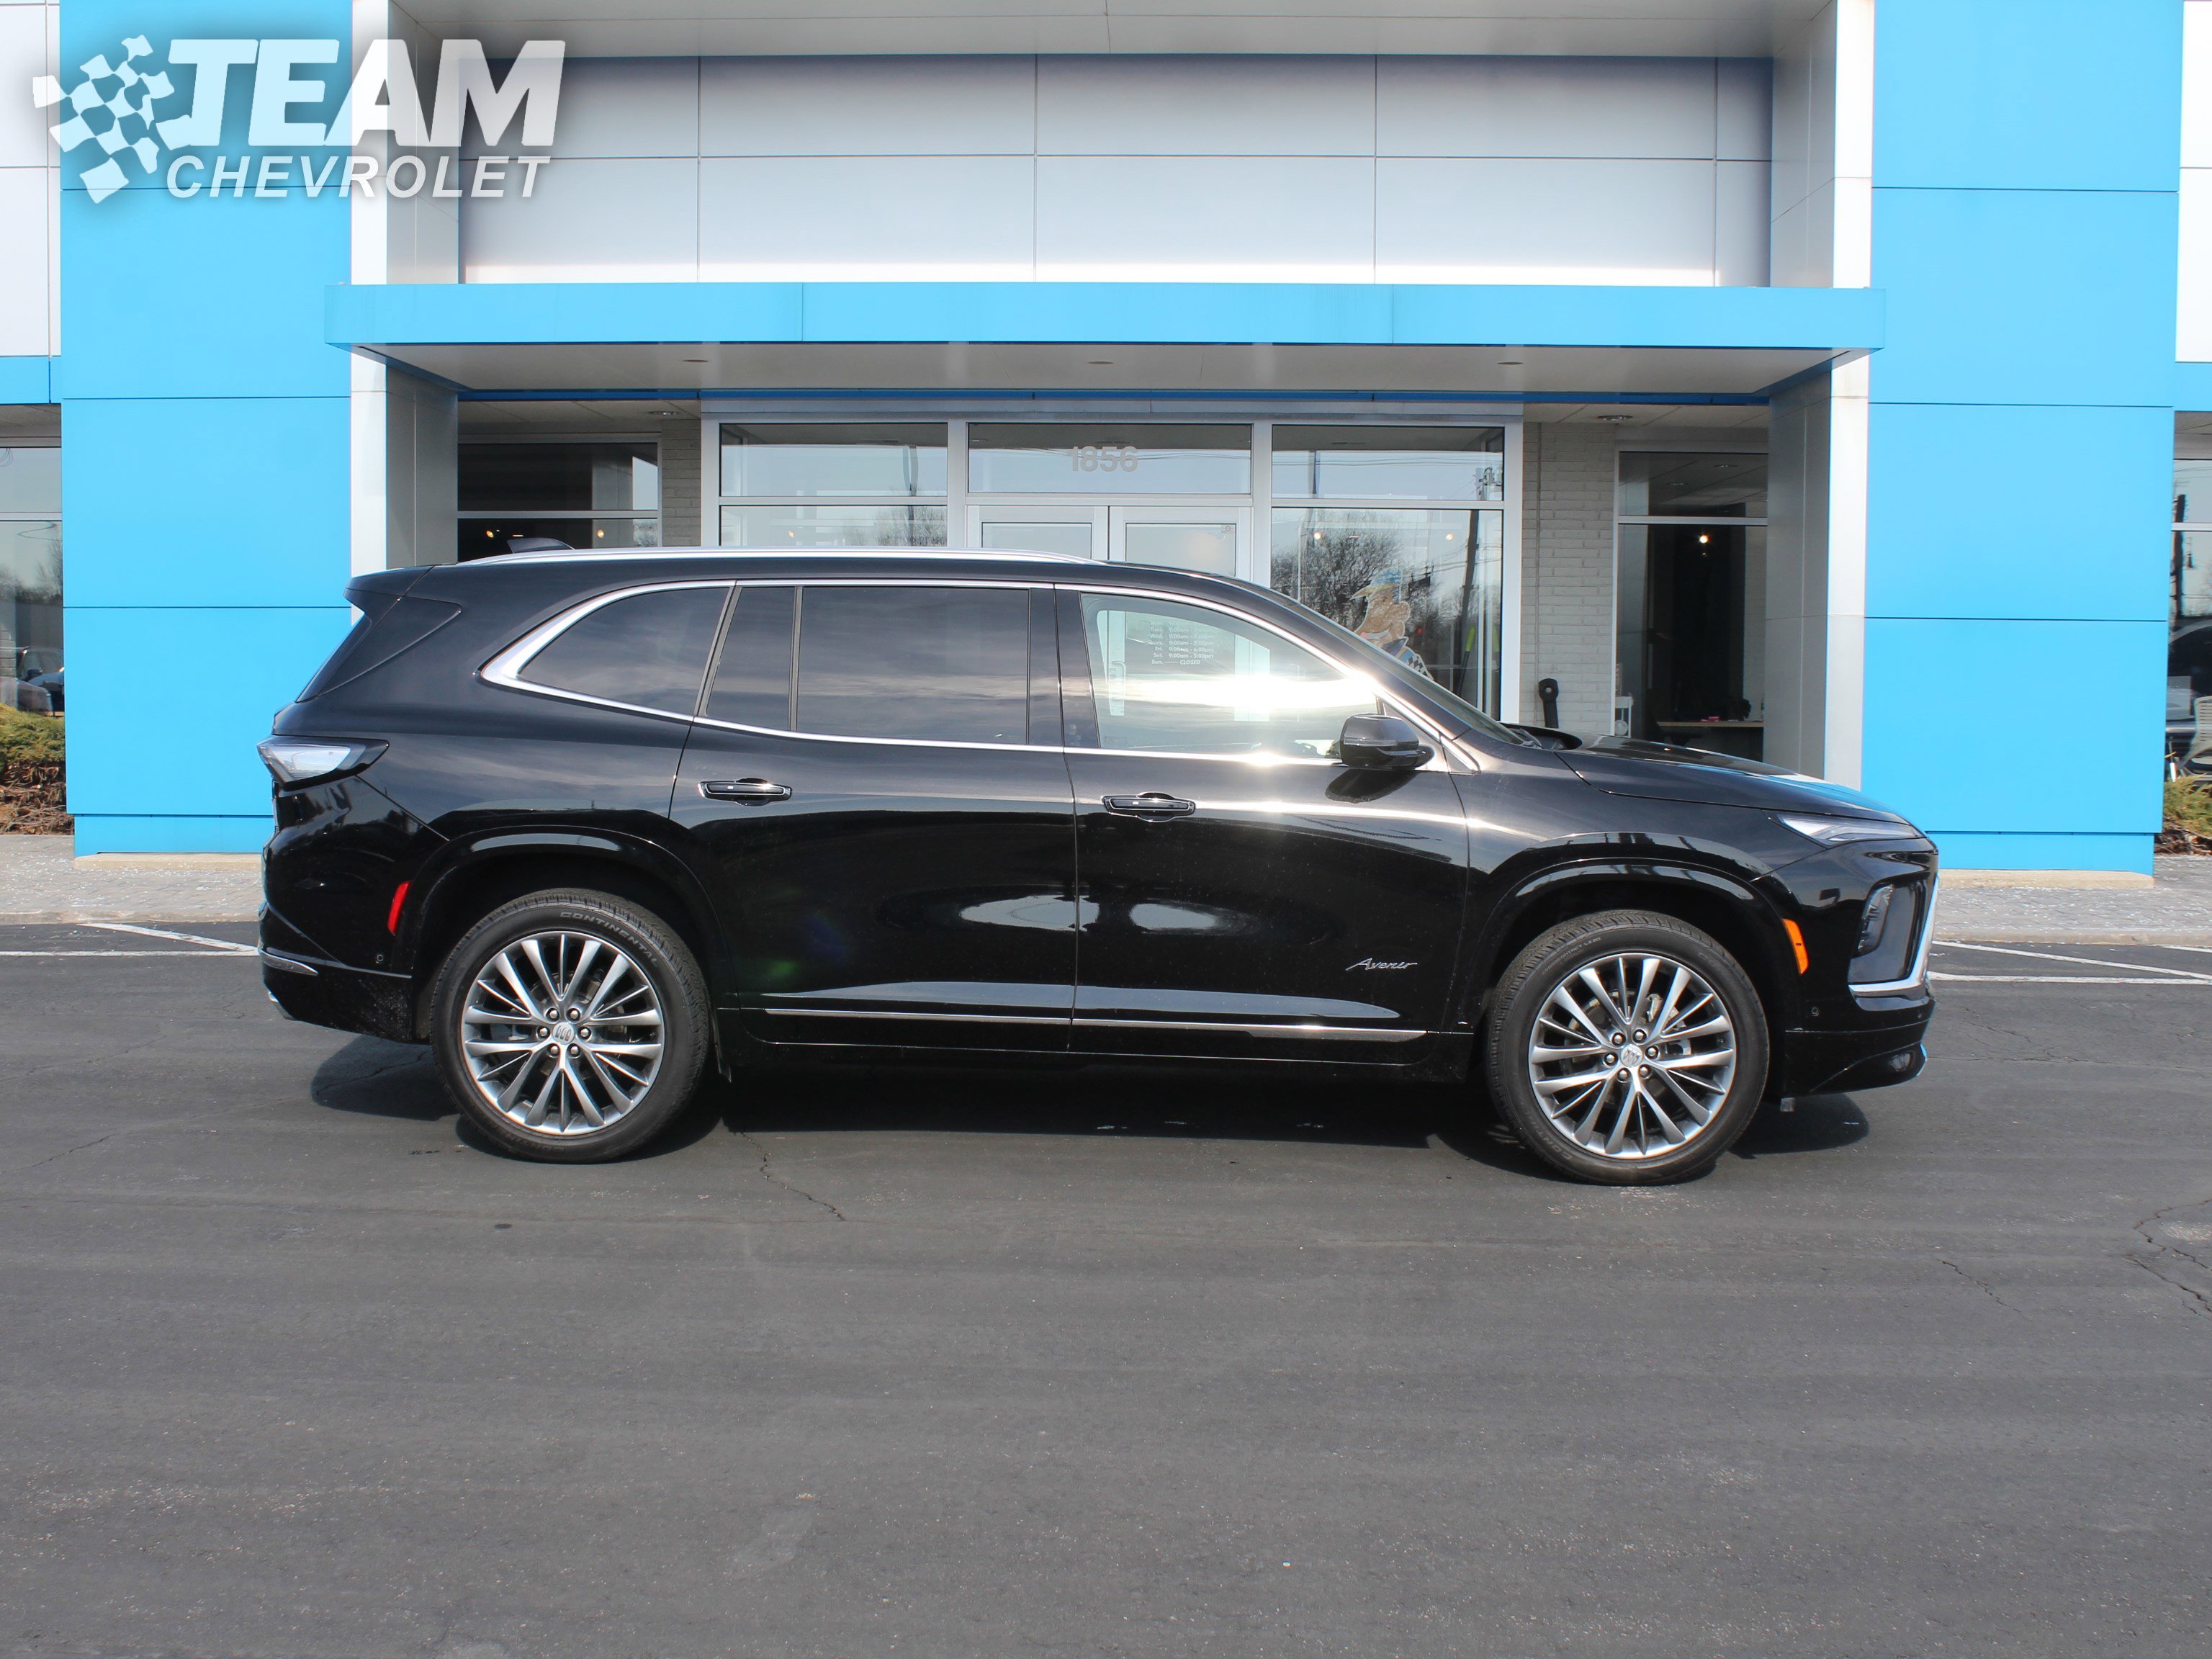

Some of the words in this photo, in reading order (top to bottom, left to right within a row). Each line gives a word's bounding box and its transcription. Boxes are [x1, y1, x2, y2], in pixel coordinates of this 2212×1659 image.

[1066, 446, 1138, 472] 1856
[559, 912, 657, 967] CONTINENTAL
[1345, 958, 1418, 971] Avenir
